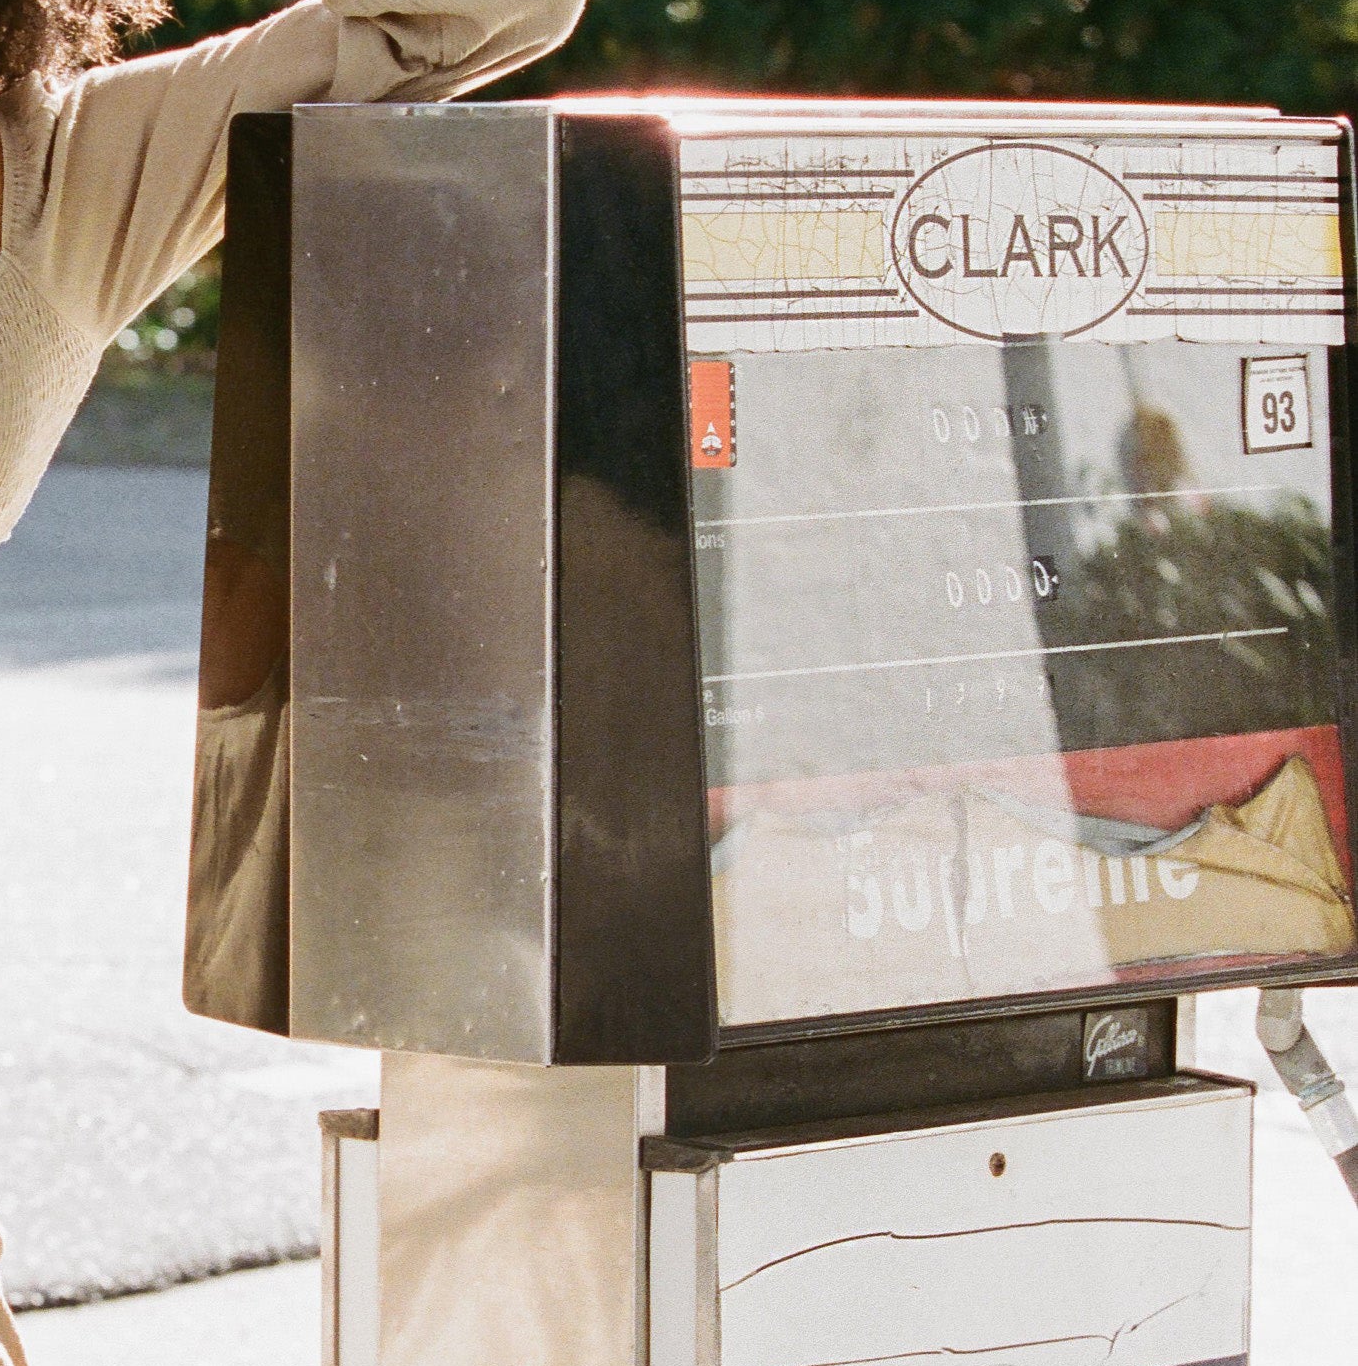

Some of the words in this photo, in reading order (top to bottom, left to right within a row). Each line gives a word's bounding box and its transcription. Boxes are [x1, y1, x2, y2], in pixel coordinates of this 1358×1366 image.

[909, 213, 1132, 279] CLARK
[1261, 391, 1296, 434] 93
[706, 707, 751, 727] Gallon
[841, 834, 1200, 957] Supreme
